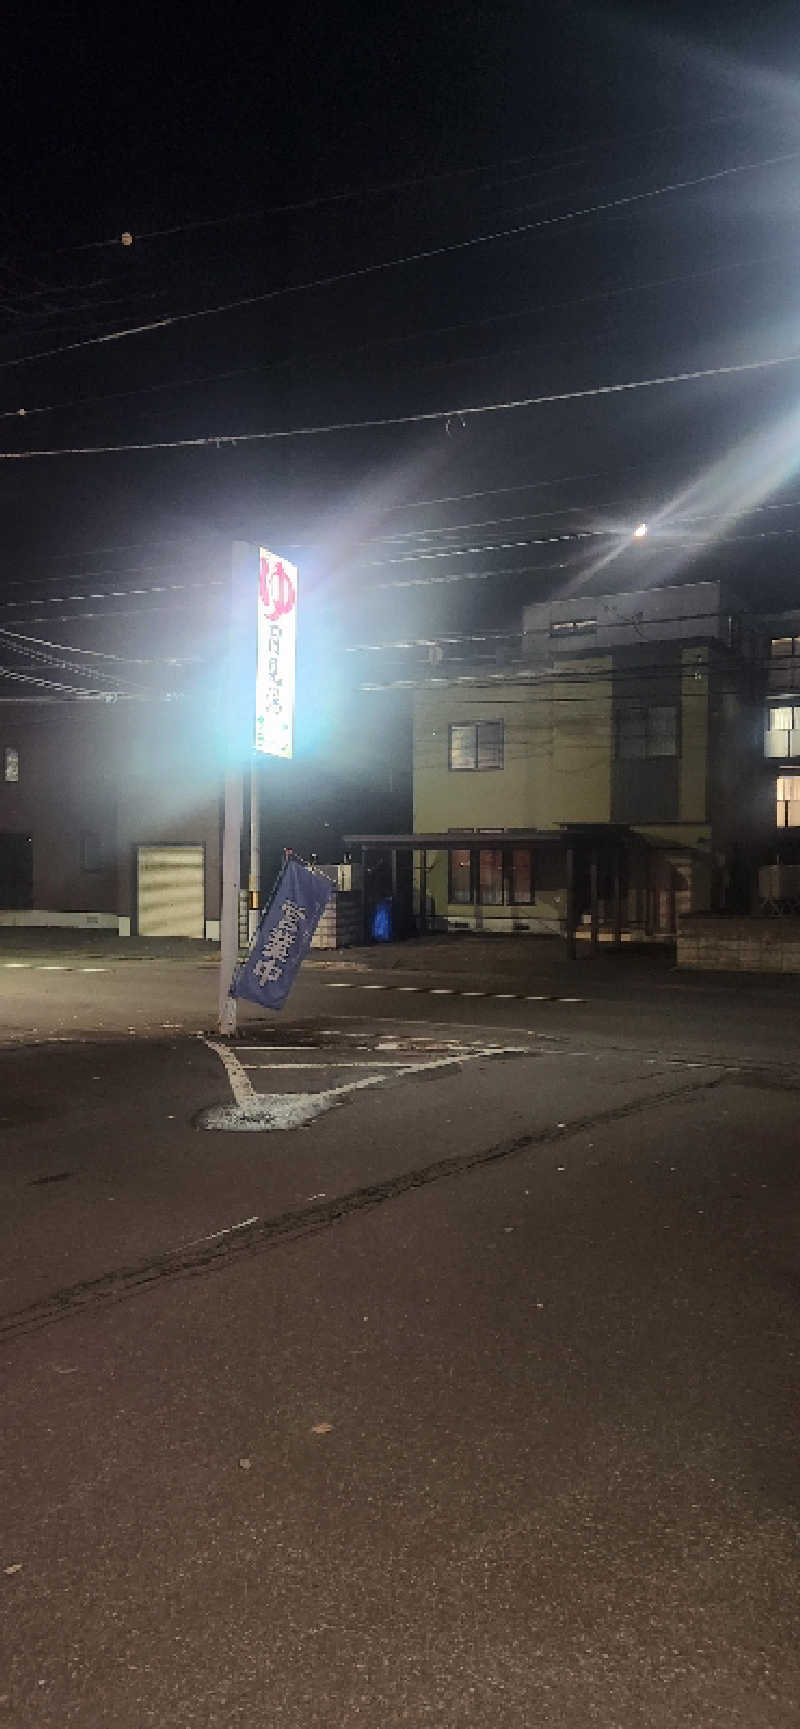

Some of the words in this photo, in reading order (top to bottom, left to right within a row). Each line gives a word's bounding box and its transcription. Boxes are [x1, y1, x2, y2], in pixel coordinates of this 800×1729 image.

[259, 557, 295, 621] ゆ
[253, 899, 306, 987] 営業中
